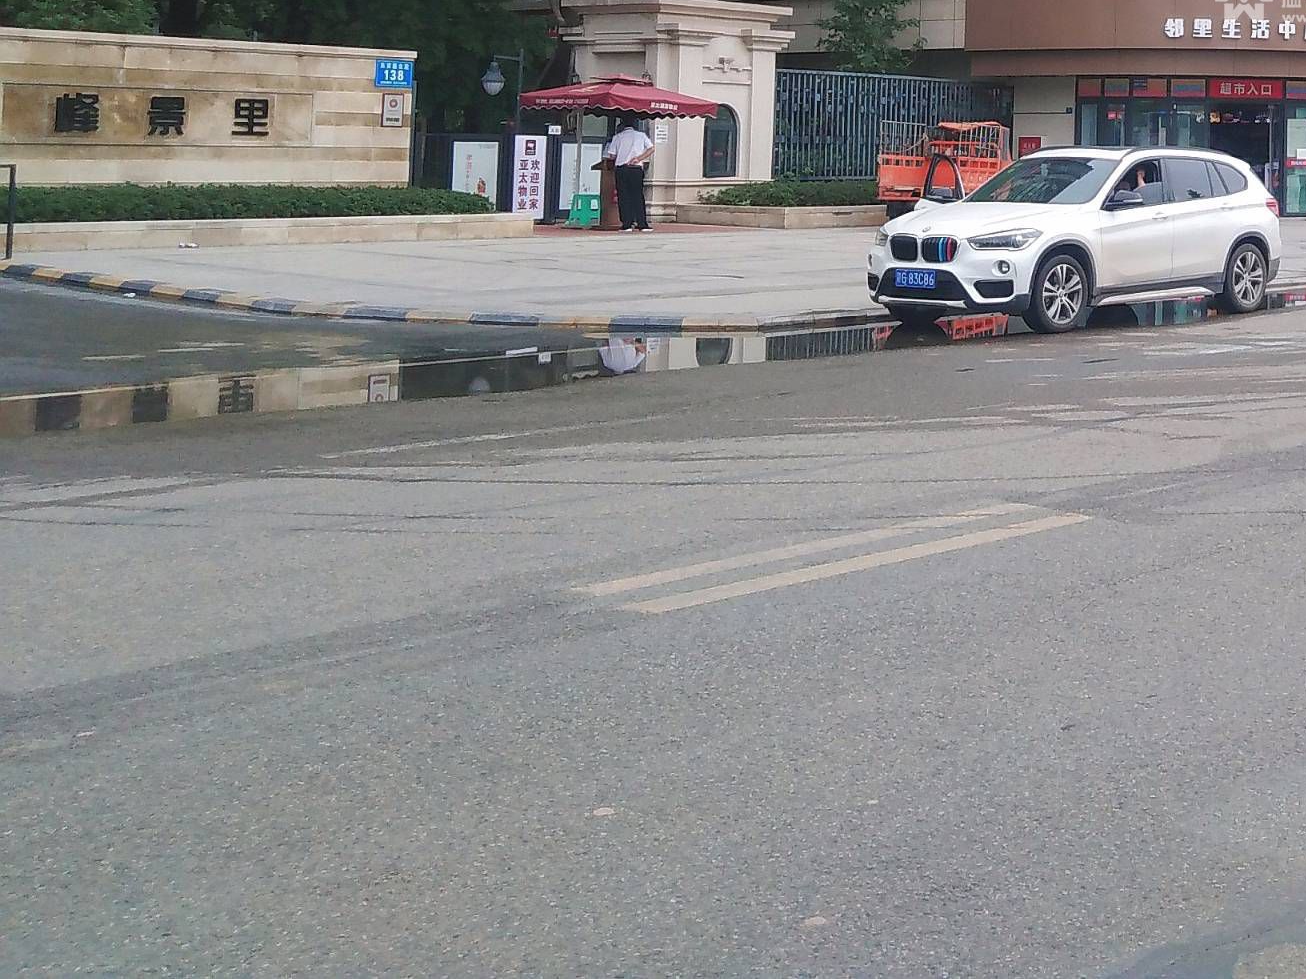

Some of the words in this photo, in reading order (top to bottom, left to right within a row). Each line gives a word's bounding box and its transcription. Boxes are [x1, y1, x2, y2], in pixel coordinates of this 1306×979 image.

[383, 69, 404, 81] 138
[1219, 81, 1273, 95] 超市入口
[517, 159, 529, 210] 亚太物业
[529, 159, 540, 210] 欢迎回家
